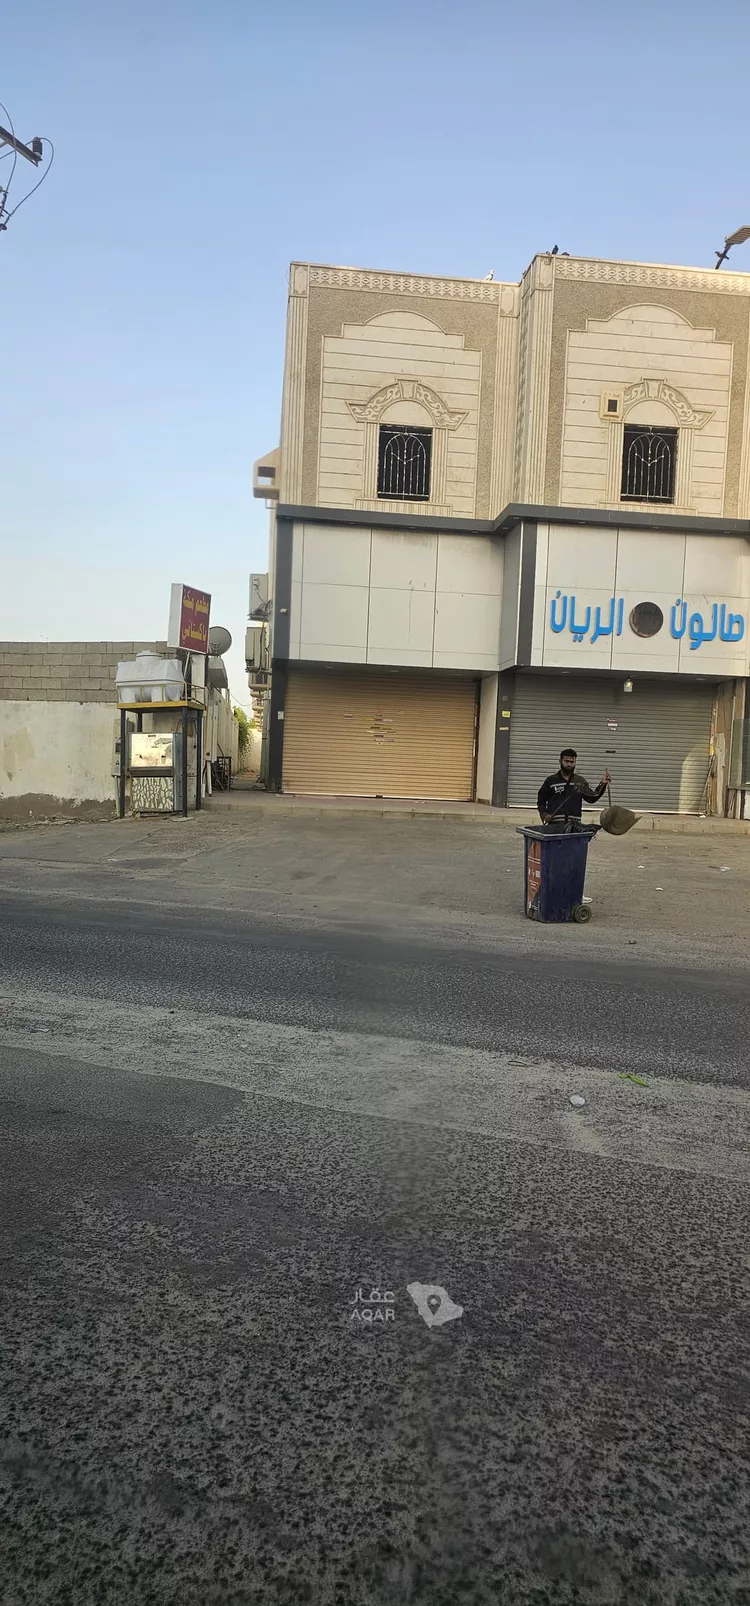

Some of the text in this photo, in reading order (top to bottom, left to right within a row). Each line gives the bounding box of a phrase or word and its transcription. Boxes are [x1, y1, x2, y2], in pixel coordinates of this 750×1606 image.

[194, 595, 209, 616] مطعم
[551, 590, 745, 650] صالون الريان
